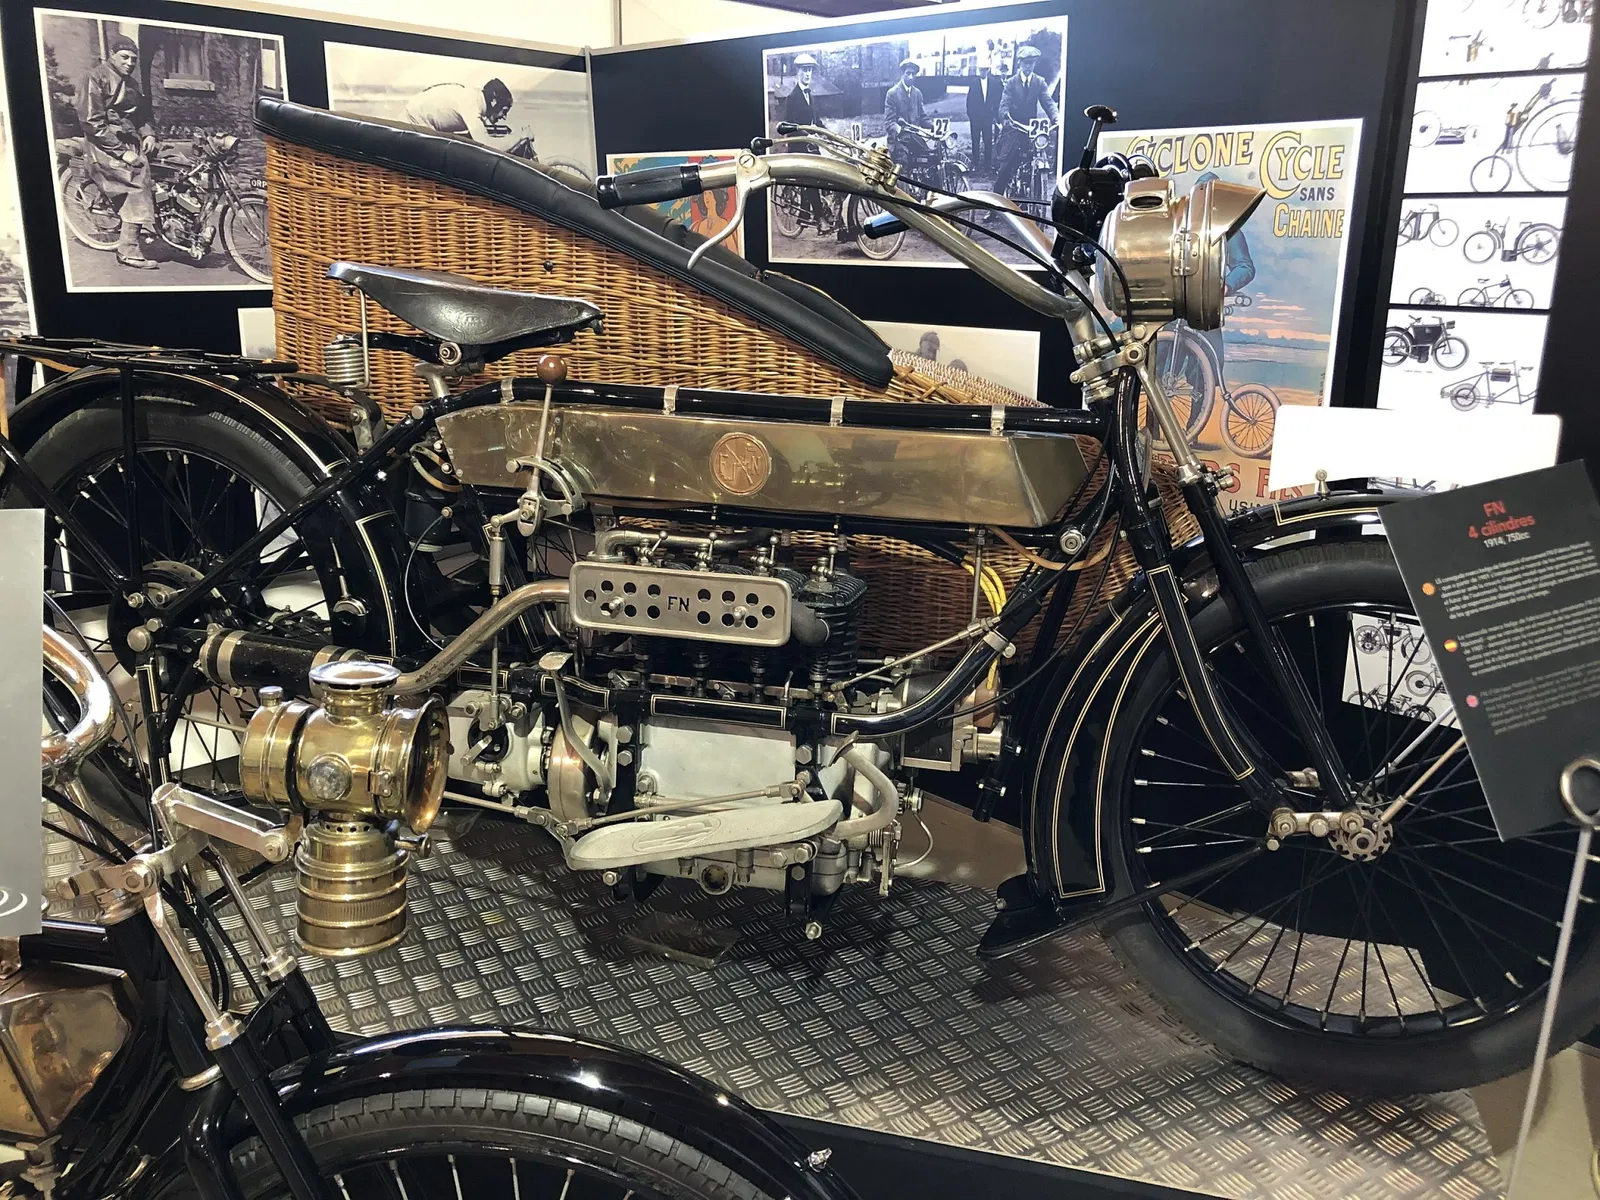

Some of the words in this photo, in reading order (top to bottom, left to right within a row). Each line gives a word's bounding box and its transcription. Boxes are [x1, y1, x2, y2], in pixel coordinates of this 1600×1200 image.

[935, 119, 949, 136] 27
[1030, 119, 1049, 136] 26
[1259, 131, 1345, 200] CYCLE
[1299, 187, 1335, 201] SANS
[1273, 202, 1345, 239] CHAINE
[1483, 501, 1506, 517] FN
[1468, 525, 1479, 538] 4
[1480, 516, 1535, 536] cilindres
[1505, 532, 1531, 542] 750cc
[667, 595, 690, 612] FN
